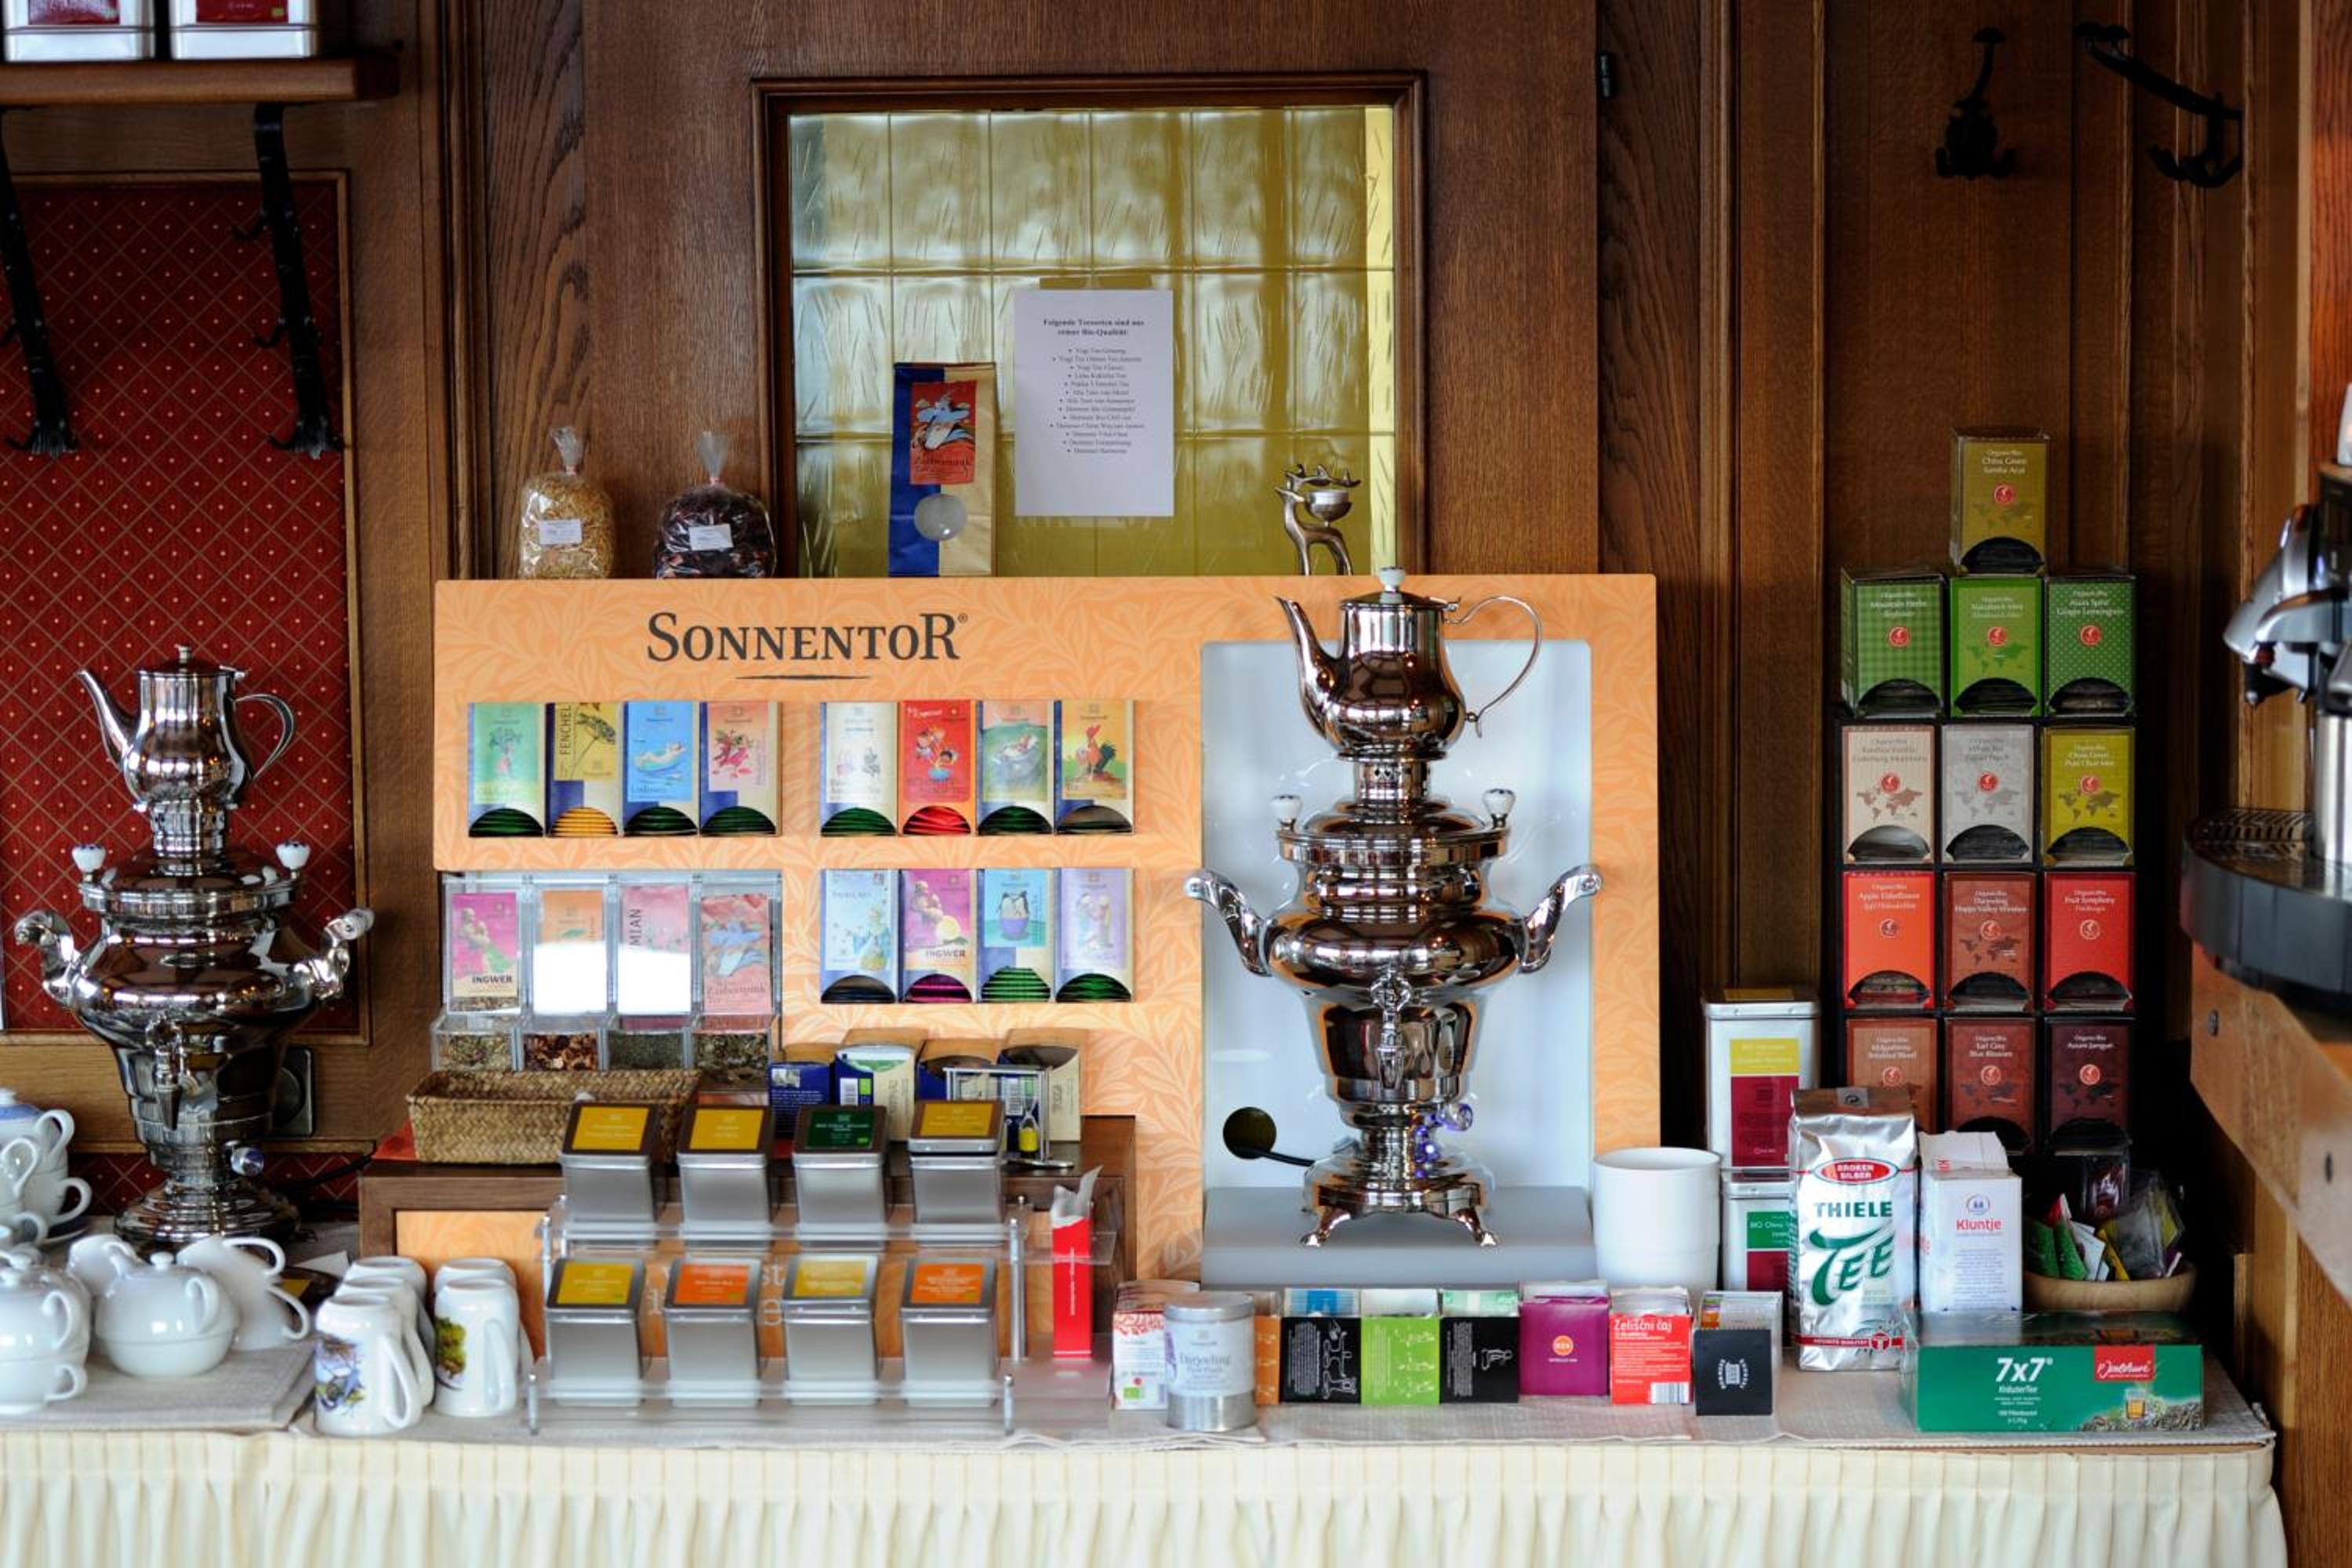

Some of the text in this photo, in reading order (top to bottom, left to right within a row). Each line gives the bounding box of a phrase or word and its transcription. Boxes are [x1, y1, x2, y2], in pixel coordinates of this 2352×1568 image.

[559, 704, 572, 756] FENCHEL
[630, 908, 642, 946] MIAN
[925, 949, 967, 959] INGWER
[472, 975, 514, 985] INGWER
[1813, 1202, 1893, 1218] THIELE
[1956, 1219, 2002, 1231] Kluntje
